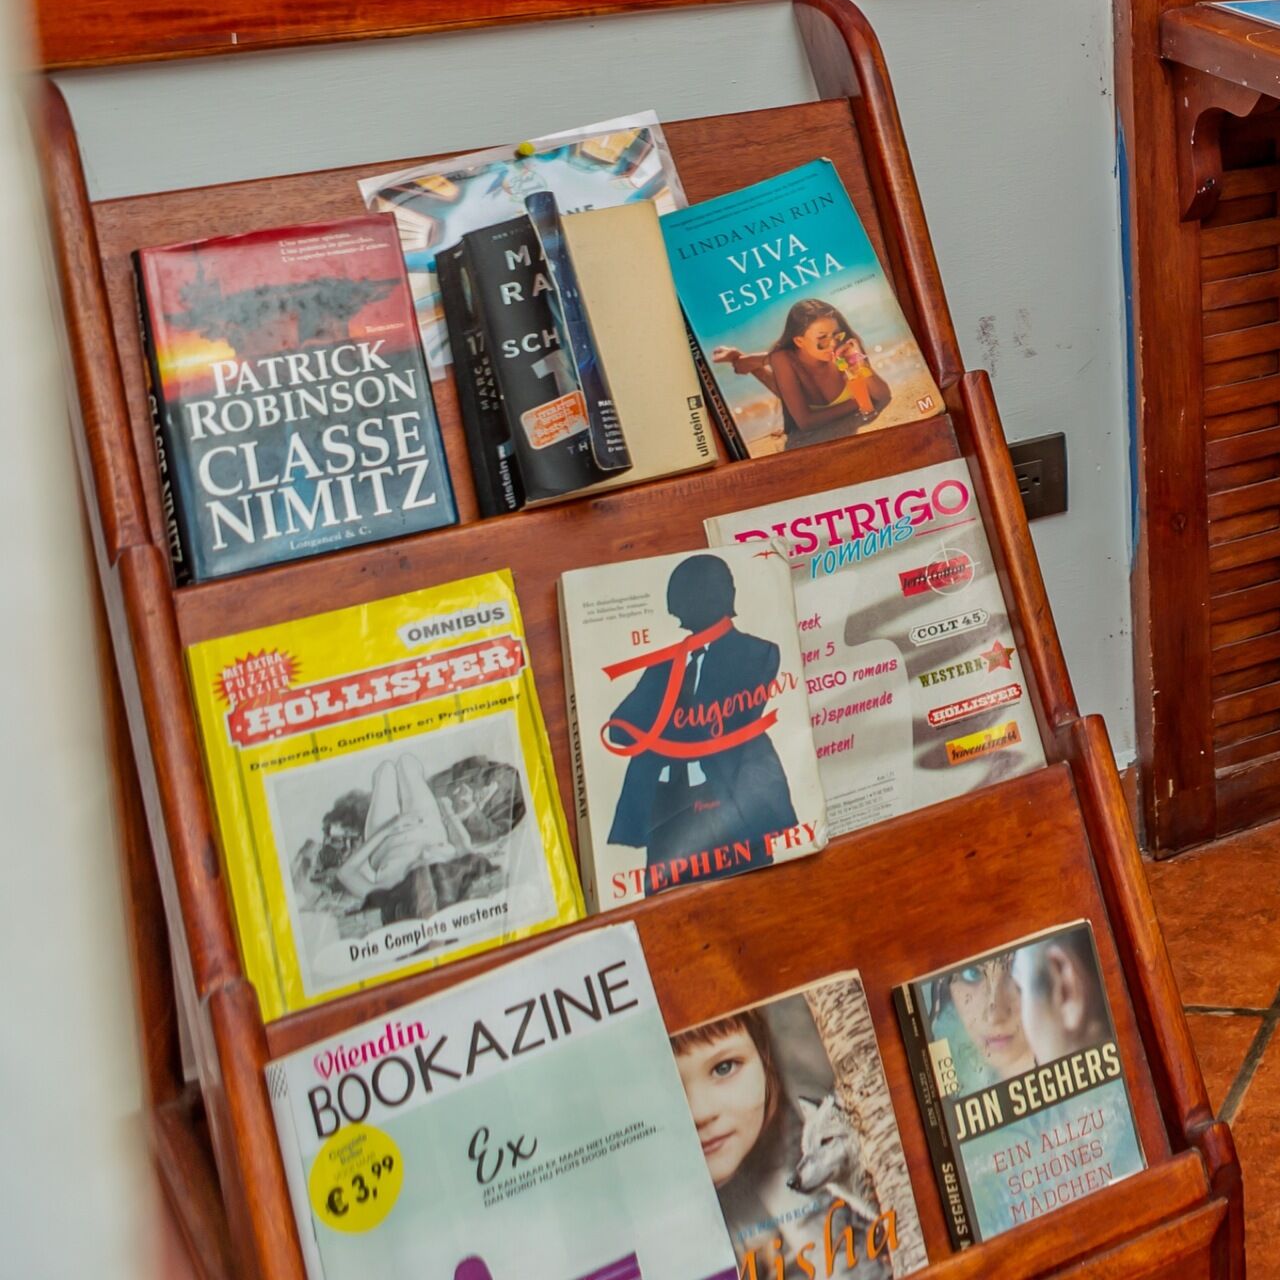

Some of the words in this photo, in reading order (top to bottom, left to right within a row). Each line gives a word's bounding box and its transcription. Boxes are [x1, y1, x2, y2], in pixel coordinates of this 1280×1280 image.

[677, 228, 743, 261] LINDA
[742, 211, 786, 236] VAN
[789, 191, 836, 220] RIJN
[725, 232, 809, 275] VIVA
[716, 252, 846, 316] ESPAÑA
[211, 339, 392, 399] PATRICK
[473, 363, 490, 411] MARC
[185, 369, 419, 442] ROBINSON
[689, 410, 710, 458] ullstein
[918, 396, 934, 411] M
[199, 411, 427, 498] CLASSE
[501, 458, 517, 510] ullstein
[205, 459, 437, 551] NIMITZ
[810, 514, 915, 580] romans
[406, 606, 506, 644] OMNIBUS
[631, 628, 651, 646] DE
[916, 618, 959, 640] COLT
[961, 611, 982, 626] 45
[223, 664, 244, 680] MET
[247, 651, 283, 673] EXTRA
[225, 663, 287, 693] PUZZEL
[242, 642, 516, 737] HOLLISTER
[852, 658, 898, 682] romans
[249, 745, 334, 772] Desperado,
[337, 722, 414, 749] Gunfighter
[416, 717, 435, 727] en
[437, 693, 522, 723] Premiejager
[932, 685, 1019, 723] HOLLISTER
[571, 721, 588, 821] LEUGENAAR
[951, 734, 1009, 762] WINCHESTER
[612, 838, 752, 901] STEPHEN
[764, 819, 820, 858] FRY
[348, 940, 380, 963] Drie
[383, 920, 449, 951] Complete
[451, 900, 510, 931] westerns
[307, 960, 639, 1141] BOOKAZINE
[313, 1020, 430, 1081] Vriendin
[937, 1056, 953, 1071] ro
[940, 1068, 956, 1082] ro
[953, 1089, 1001, 1140] JAN
[1010, 1041, 1122, 1116] SEGHERS
[467, 1125, 538, 1185] Ex
[518, 1165, 544, 1183] HAAR
[559, 1147, 584, 1163] MAAR
[586, 1138, 603, 1153] NIET
[604, 1120, 645, 1145] LOSLATEN
[991, 1139, 1031, 1174] EIN
[1040, 1109, 1106, 1153] ALLZU
[325, 1185, 350, 1218] €
[351, 1154, 395, 1204] 3,99
[942, 1162, 968, 1236] SEGHERS
